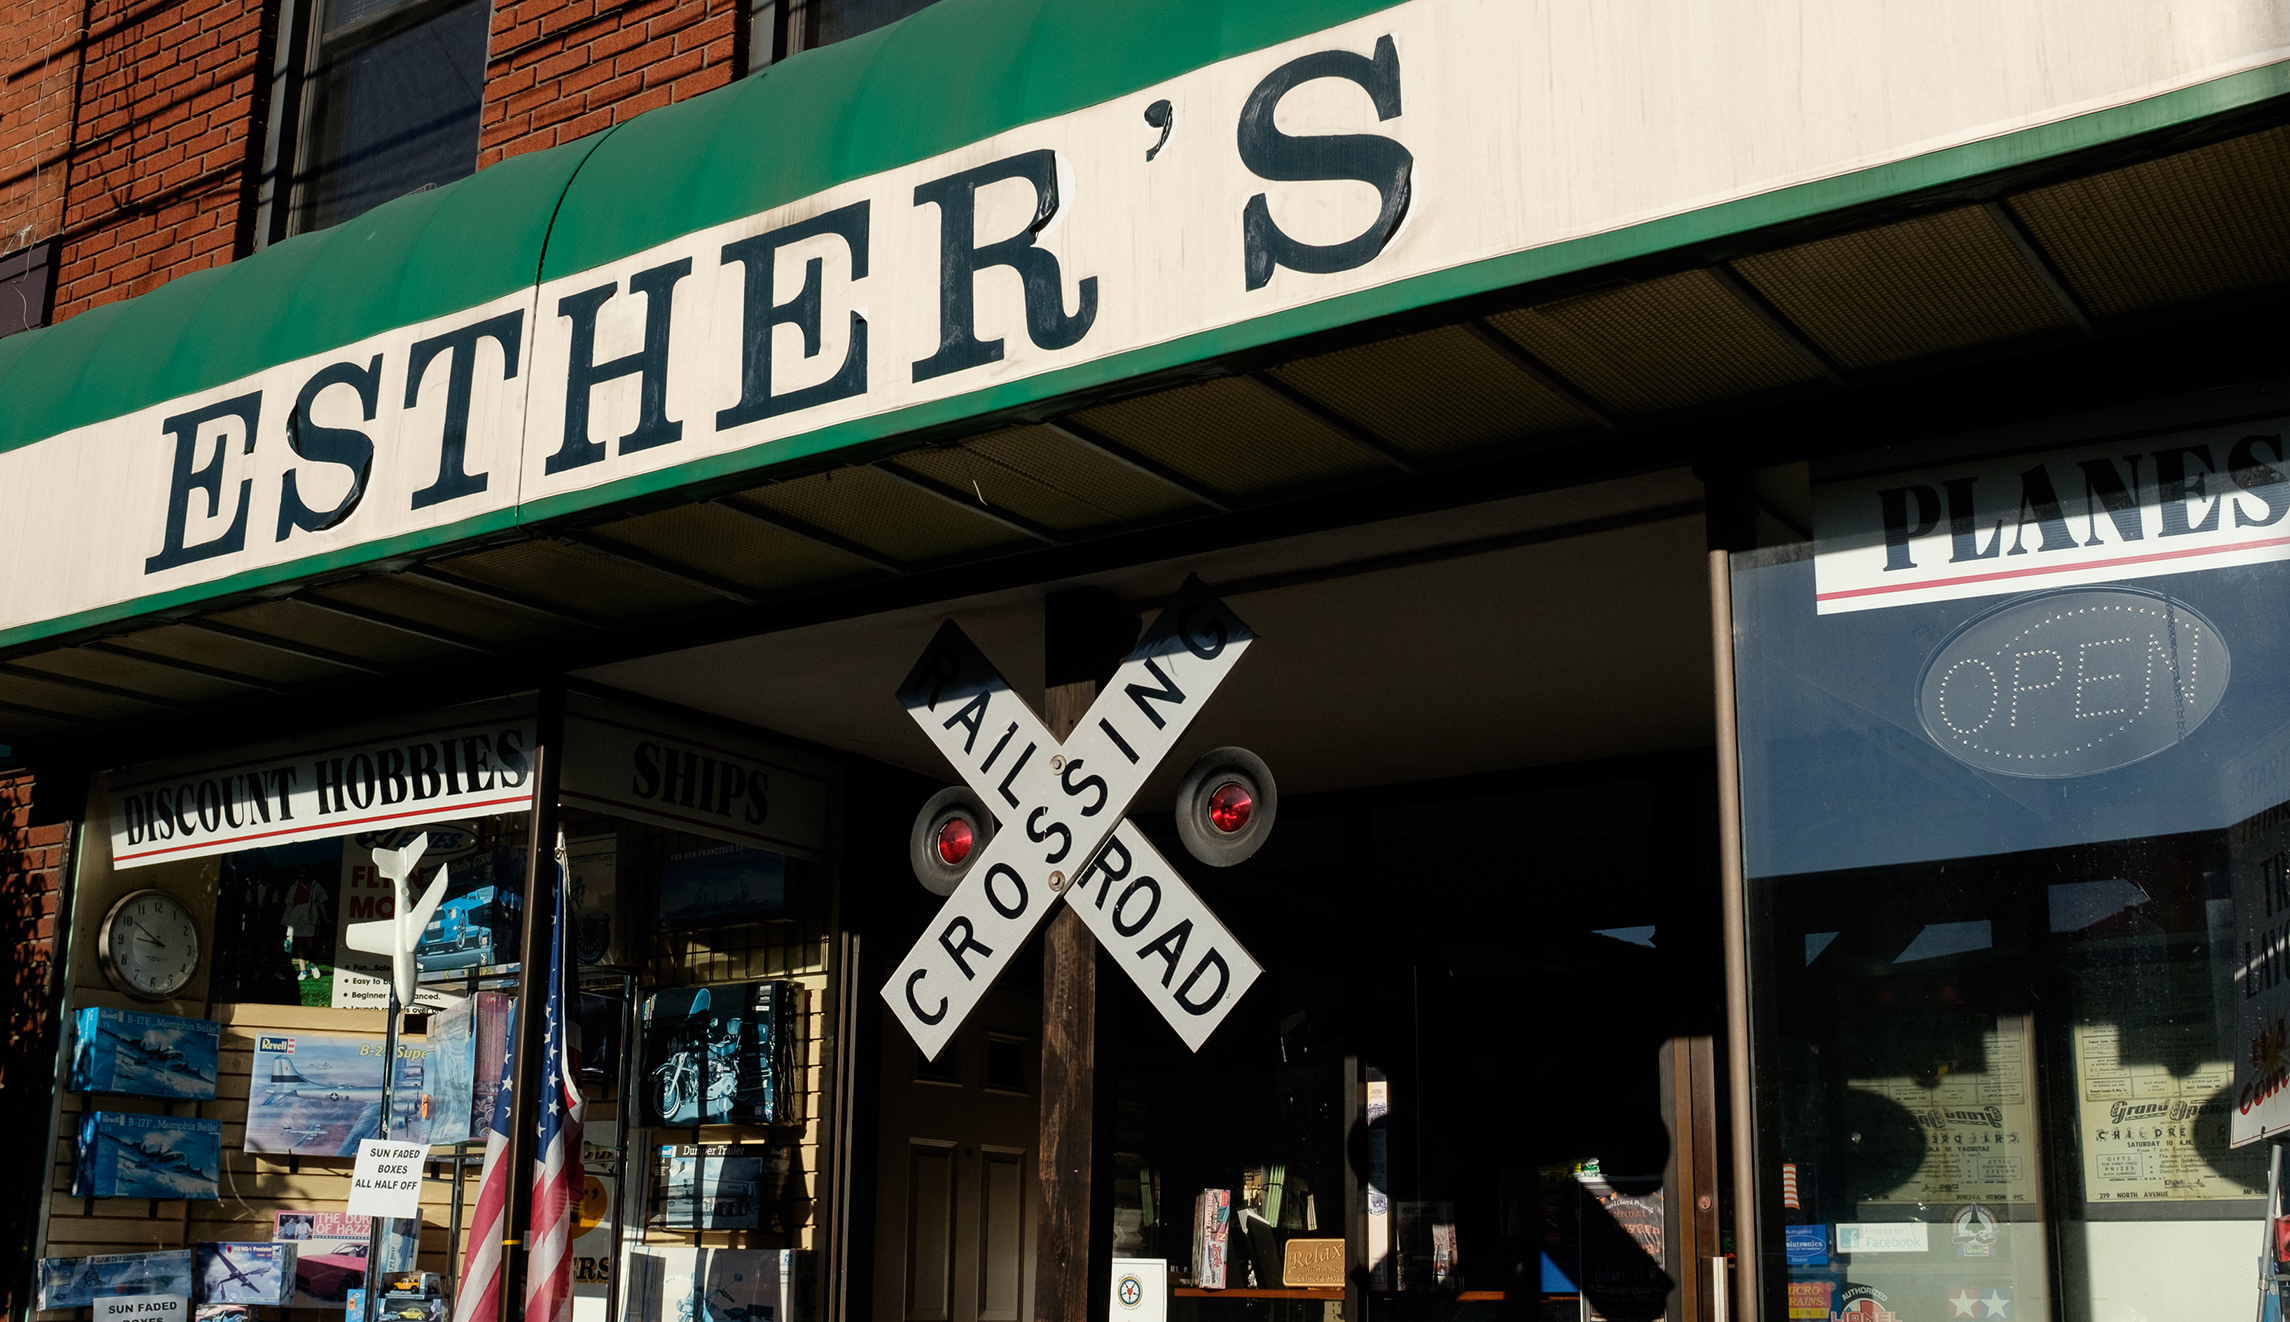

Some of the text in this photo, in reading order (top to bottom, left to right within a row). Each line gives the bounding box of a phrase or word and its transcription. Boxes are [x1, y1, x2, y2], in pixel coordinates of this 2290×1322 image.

[144, 33, 1415, 576] ESTHER'S
[1877, 433, 2290, 572] PLANES
[1939, 626, 2200, 736] OPEN
[123, 729, 531, 847] DISCOUNT HOBBIES
[632, 740, 769, 826] SHIPS
[904, 602, 1228, 1026] CROSSING
[394, 831, 462, 849] ETES.
[154, 902, 163, 914] 12
[123, 915, 133, 926] 10
[183, 925, 188, 937] 2
[118, 934, 124, 945] 9
[186, 945, 192, 956] 3
[121, 954, 128, 965] 8
[133, 969, 140, 981] 7
[352, 977, 371, 986] Easy
[372, 977, 381, 985] to
[351, 991, 387, 1000] Beginner
[127, 1015, 151, 1026] B-17F
[262, 1037, 288, 1051] Revell
[360, 1044, 387, 1057] B-2
[2110, 1099, 2171, 1124] Grand
[128, 1118, 151, 1128] B-17F
[2127, 1140, 2160, 1148] SATURDAY
[370, 1148, 420, 1159] SUN FADED
[682, 1145, 716, 1157] Dumper
[717, 1144, 745, 1156] Trailer
[377, 1164, 408, 1174] BOXES
[355, 1179, 417, 1191] ALL HALF OFF
[316, 1213, 341, 1224] THE
[316, 1224, 333, 1234] OF
[1865, 1227, 1881, 1235] Find
[1866, 1237, 1921, 1248] Facebook
[1289, 1242, 1344, 1270] Relax
[1841, 1286, 1888, 1301] AUTHORIZED
[108, 1301, 178, 1315] SUN FADED
